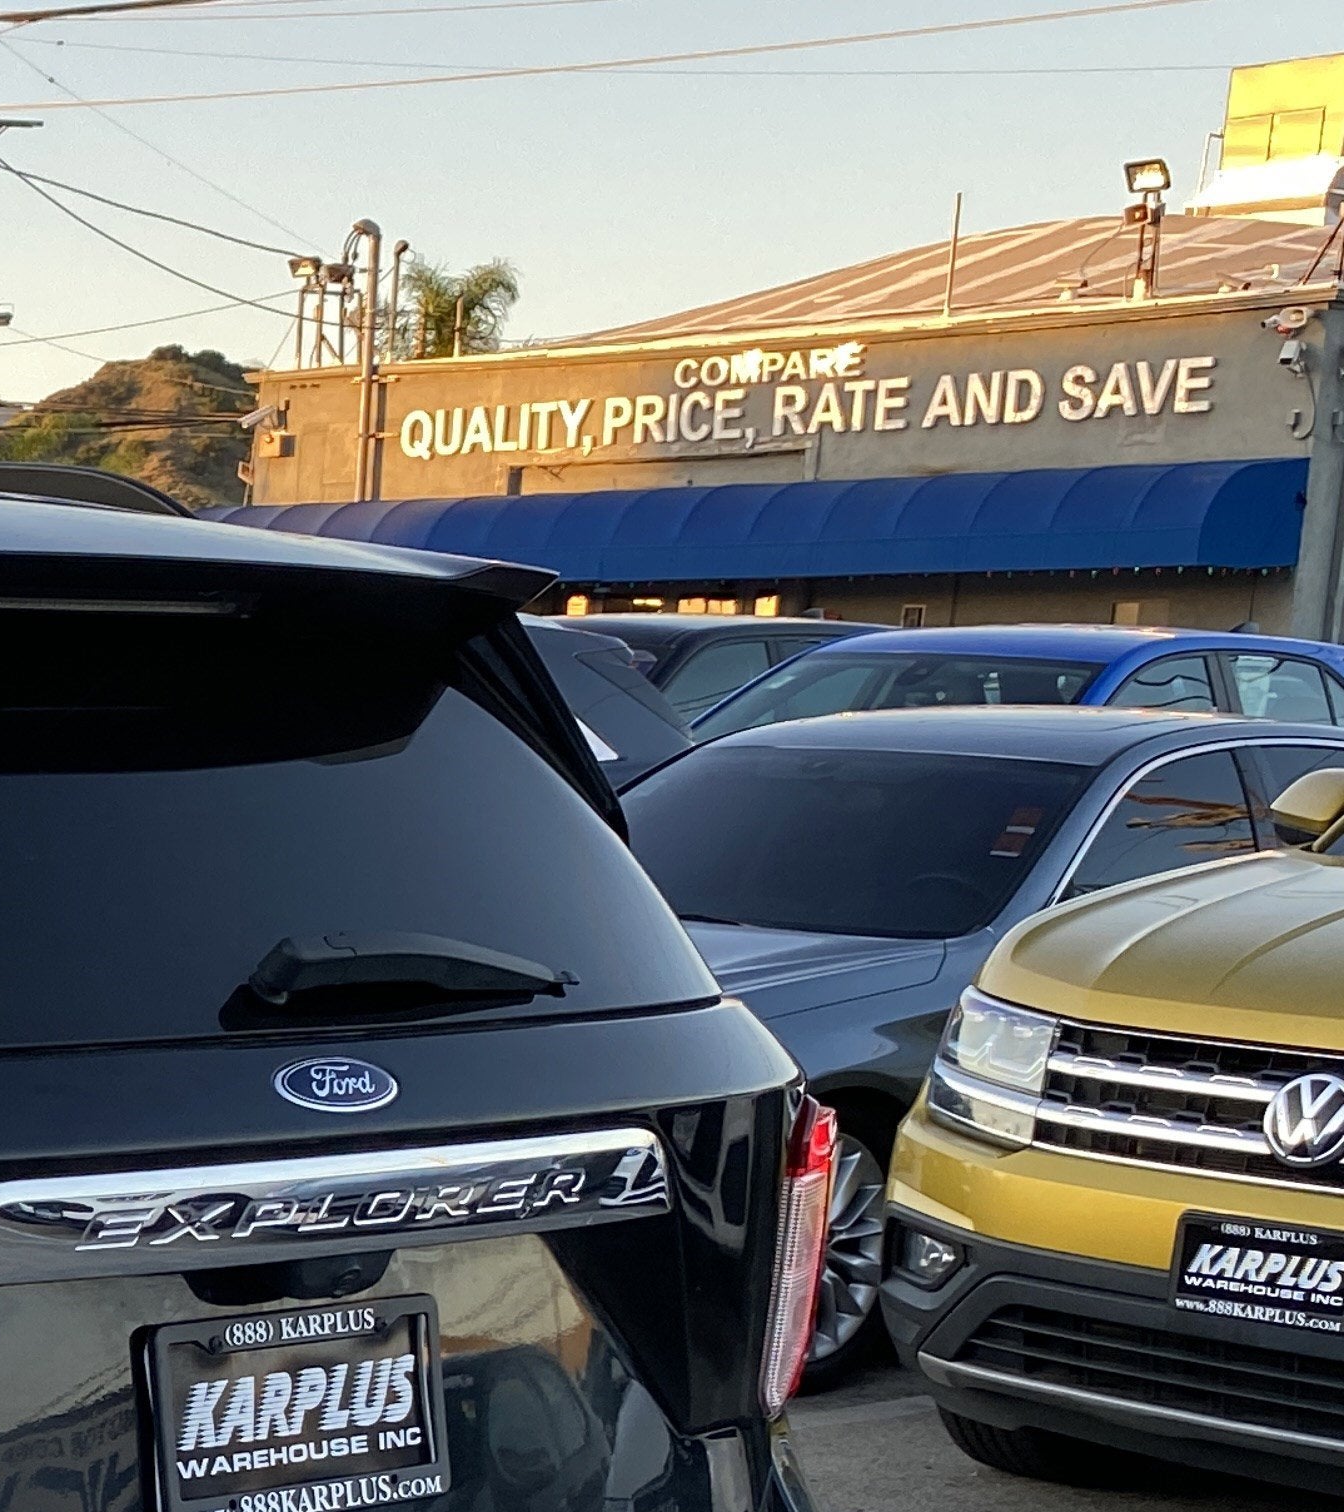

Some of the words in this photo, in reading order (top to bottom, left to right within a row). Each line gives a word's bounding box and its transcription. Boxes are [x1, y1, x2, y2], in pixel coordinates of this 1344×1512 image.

[674, 342, 866, 389] COMPARE
[400, 398, 595, 460] QUALITY,
[603, 387, 756, 449] PRICE,
[771, 377, 911, 437] RATE
[921, 368, 1045, 428] AND
[1058, 356, 1216, 422] SAVE
[310, 1065, 376, 1098] Ford
[75, 1168, 587, 1251] EXPLORER
[1254, 1228, 1318, 1245] KARPLUS
[1184, 1275, 1305, 1301] WAREHOUSE
[1311, 1294, 1344, 1307] INC
[1187, 1243, 1344, 1293] KARPLUS
[225, 1321, 274, 1347] (888)
[281, 1308, 376, 1340] KARPLUS
[176, 1354, 415, 1451] KARPLUS
[176, 1435, 369, 1479] WAREHOUSE
[378, 1427, 422, 1450] INC
